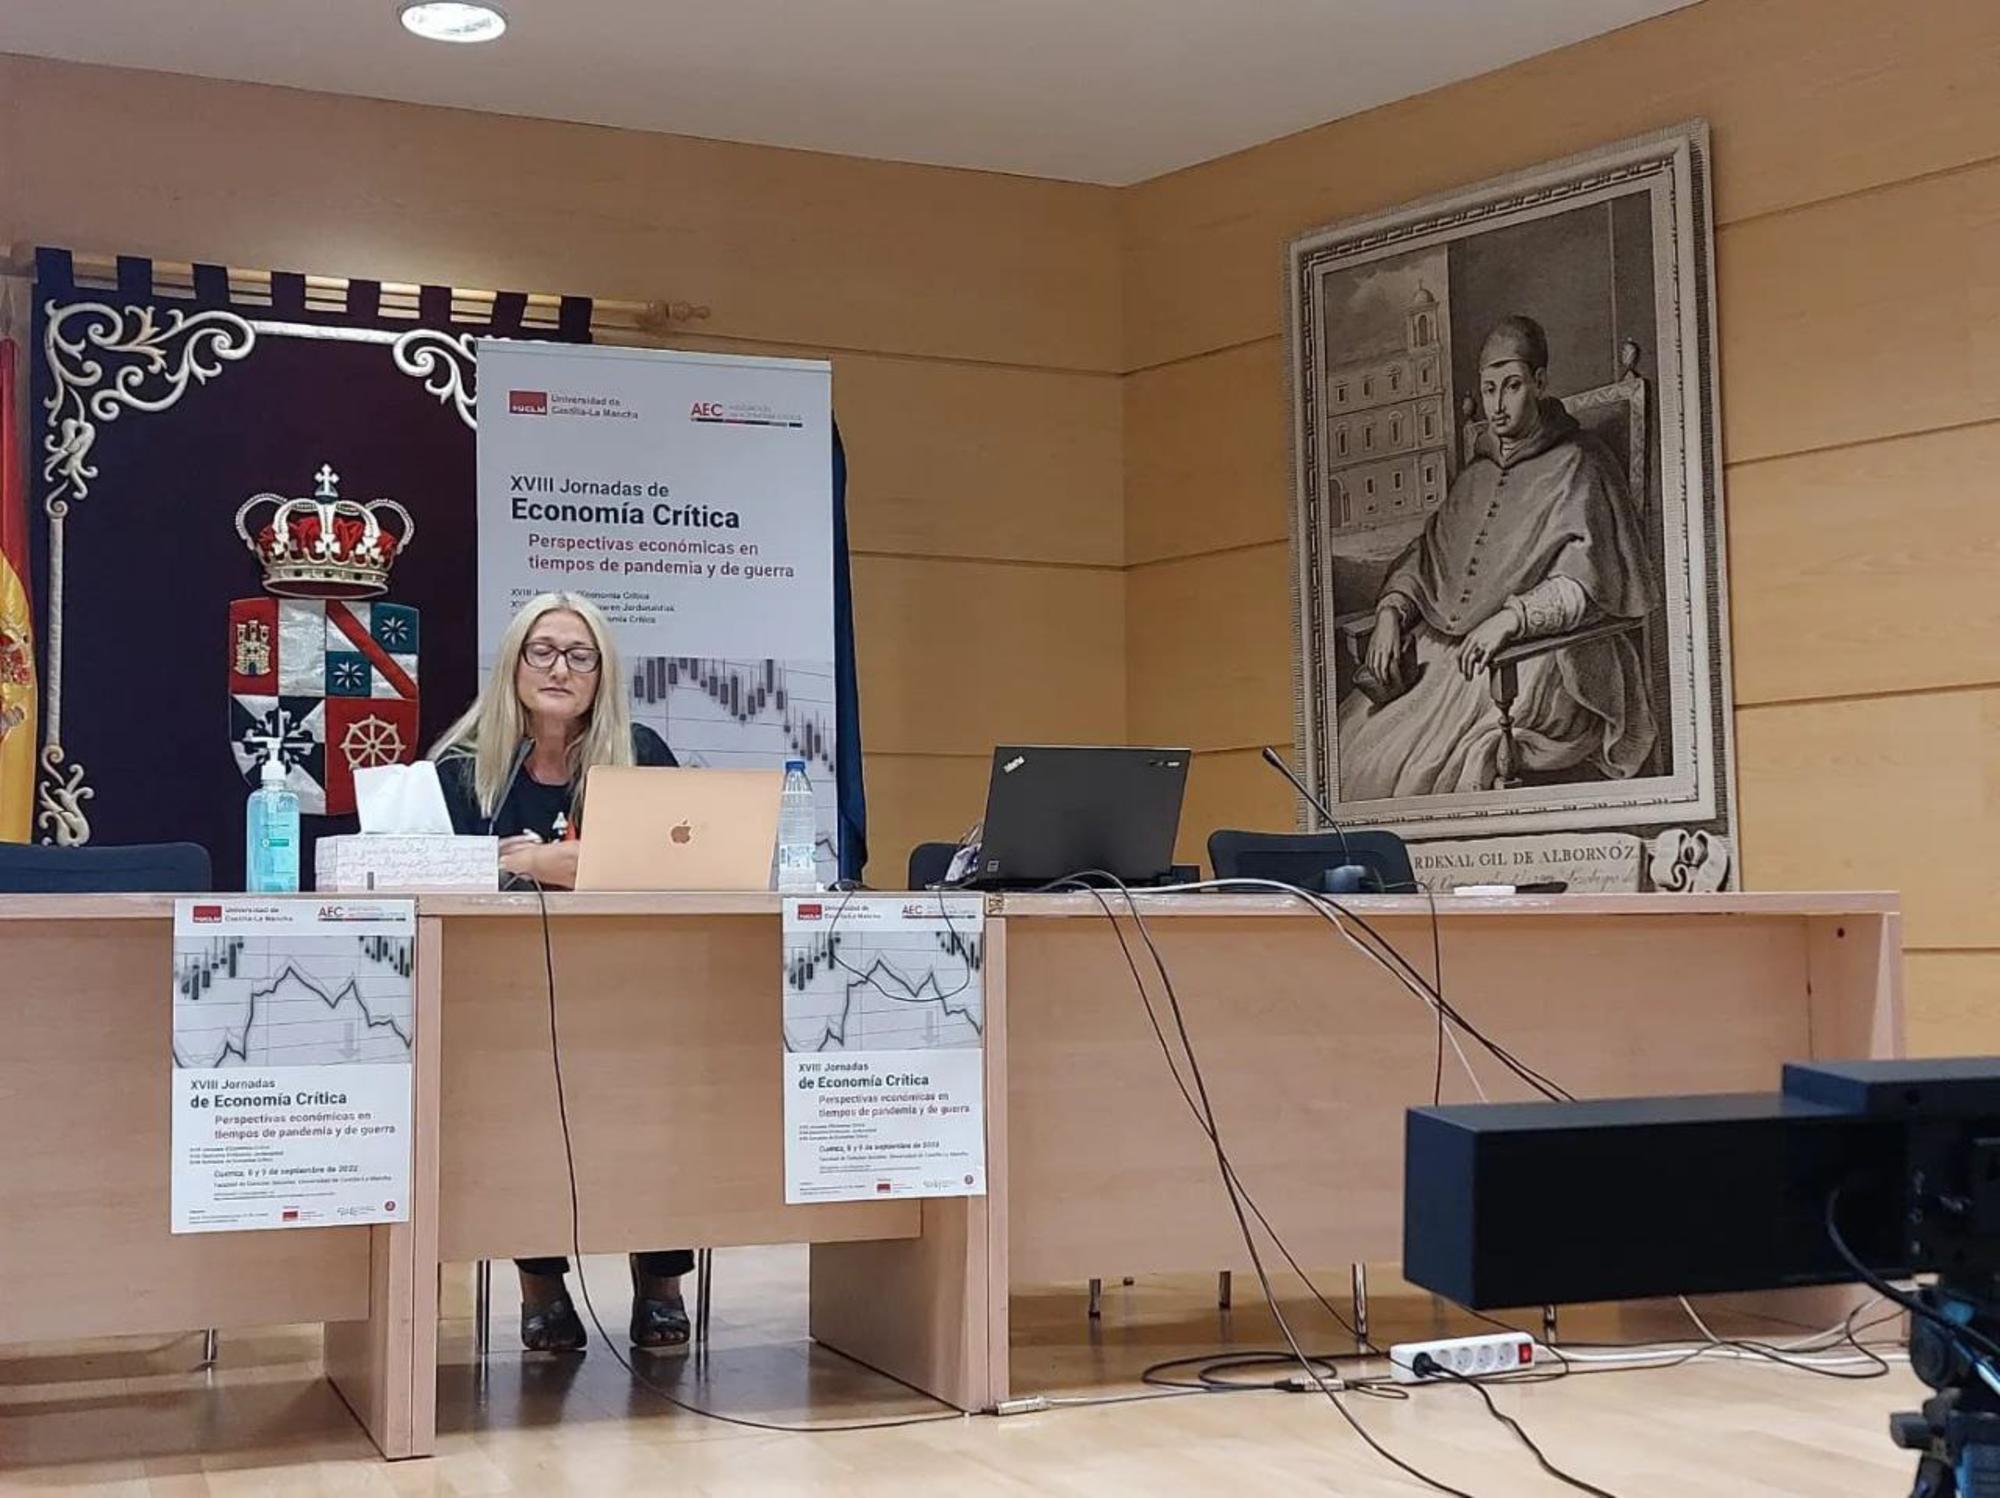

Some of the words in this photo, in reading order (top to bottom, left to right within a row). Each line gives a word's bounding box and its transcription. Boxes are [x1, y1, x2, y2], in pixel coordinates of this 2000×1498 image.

[551, 393, 607, 406] Universidad
[603, 408, 639, 419] Mancha
[691, 402, 723, 417] AEC
[510, 475, 554, 492] XVIII
[560, 478, 643, 496] Jornadas
[647, 482, 669, 497] de
[512, 497, 644, 525] Economía
[653, 503, 740, 528] Crítica
[528, 533, 634, 552] Perspectivas
[639, 538, 735, 555] económicas
[740, 543, 759, 555] en
[528, 554, 595, 573] tiempos
[600, 556, 620, 572] de
[624, 559, 703, 576] pandemia
[707, 564, 716, 578] y
[720, 561, 740, 576] de
[744, 564, 795, 580] guerra
[1413, 853, 1475, 869] RDENAL
[1479, 850, 1508, 866] GIL
[1513, 850, 1535, 865] DE
[318, 906, 345, 918] AEC
[902, 905, 924, 915] AEC
[824, 1061, 869, 1072] Jornadas
[190, 1079, 219, 1090] XVIII
[221, 1077, 276, 1089] Jornadas
[799, 1076, 815, 1089] de
[818, 1074, 882, 1088] Economía
[886, 1073, 929, 1086] Crítica
[190, 1094, 209, 1108] de
[214, 1091, 292, 1107] Economía
[296, 1091, 348, 1105] Crítica
[818, 1094, 878, 1106] Perspectivas
[938, 1092, 949, 1101] en
[215, 1114, 286, 1126] Perspectivas
[289, 1111, 356, 1122] económicas
[358, 1111, 371, 1120] en
[818, 1107, 857, 1118] tiempos
[858, 1106, 870, 1116] de
[872, 1105, 918, 1118] pandemia
[927, 1104, 938, 1114] de
[940, 1105, 970, 1116] guerra
[215, 1129, 259, 1140] tiempos
[262, 1128, 277, 1138] de
[279, 1126, 333, 1138] pandemia
[335, 1127, 342, 1138] y
[344, 1125, 359, 1135] de
[360, 1125, 396, 1137] guerra
